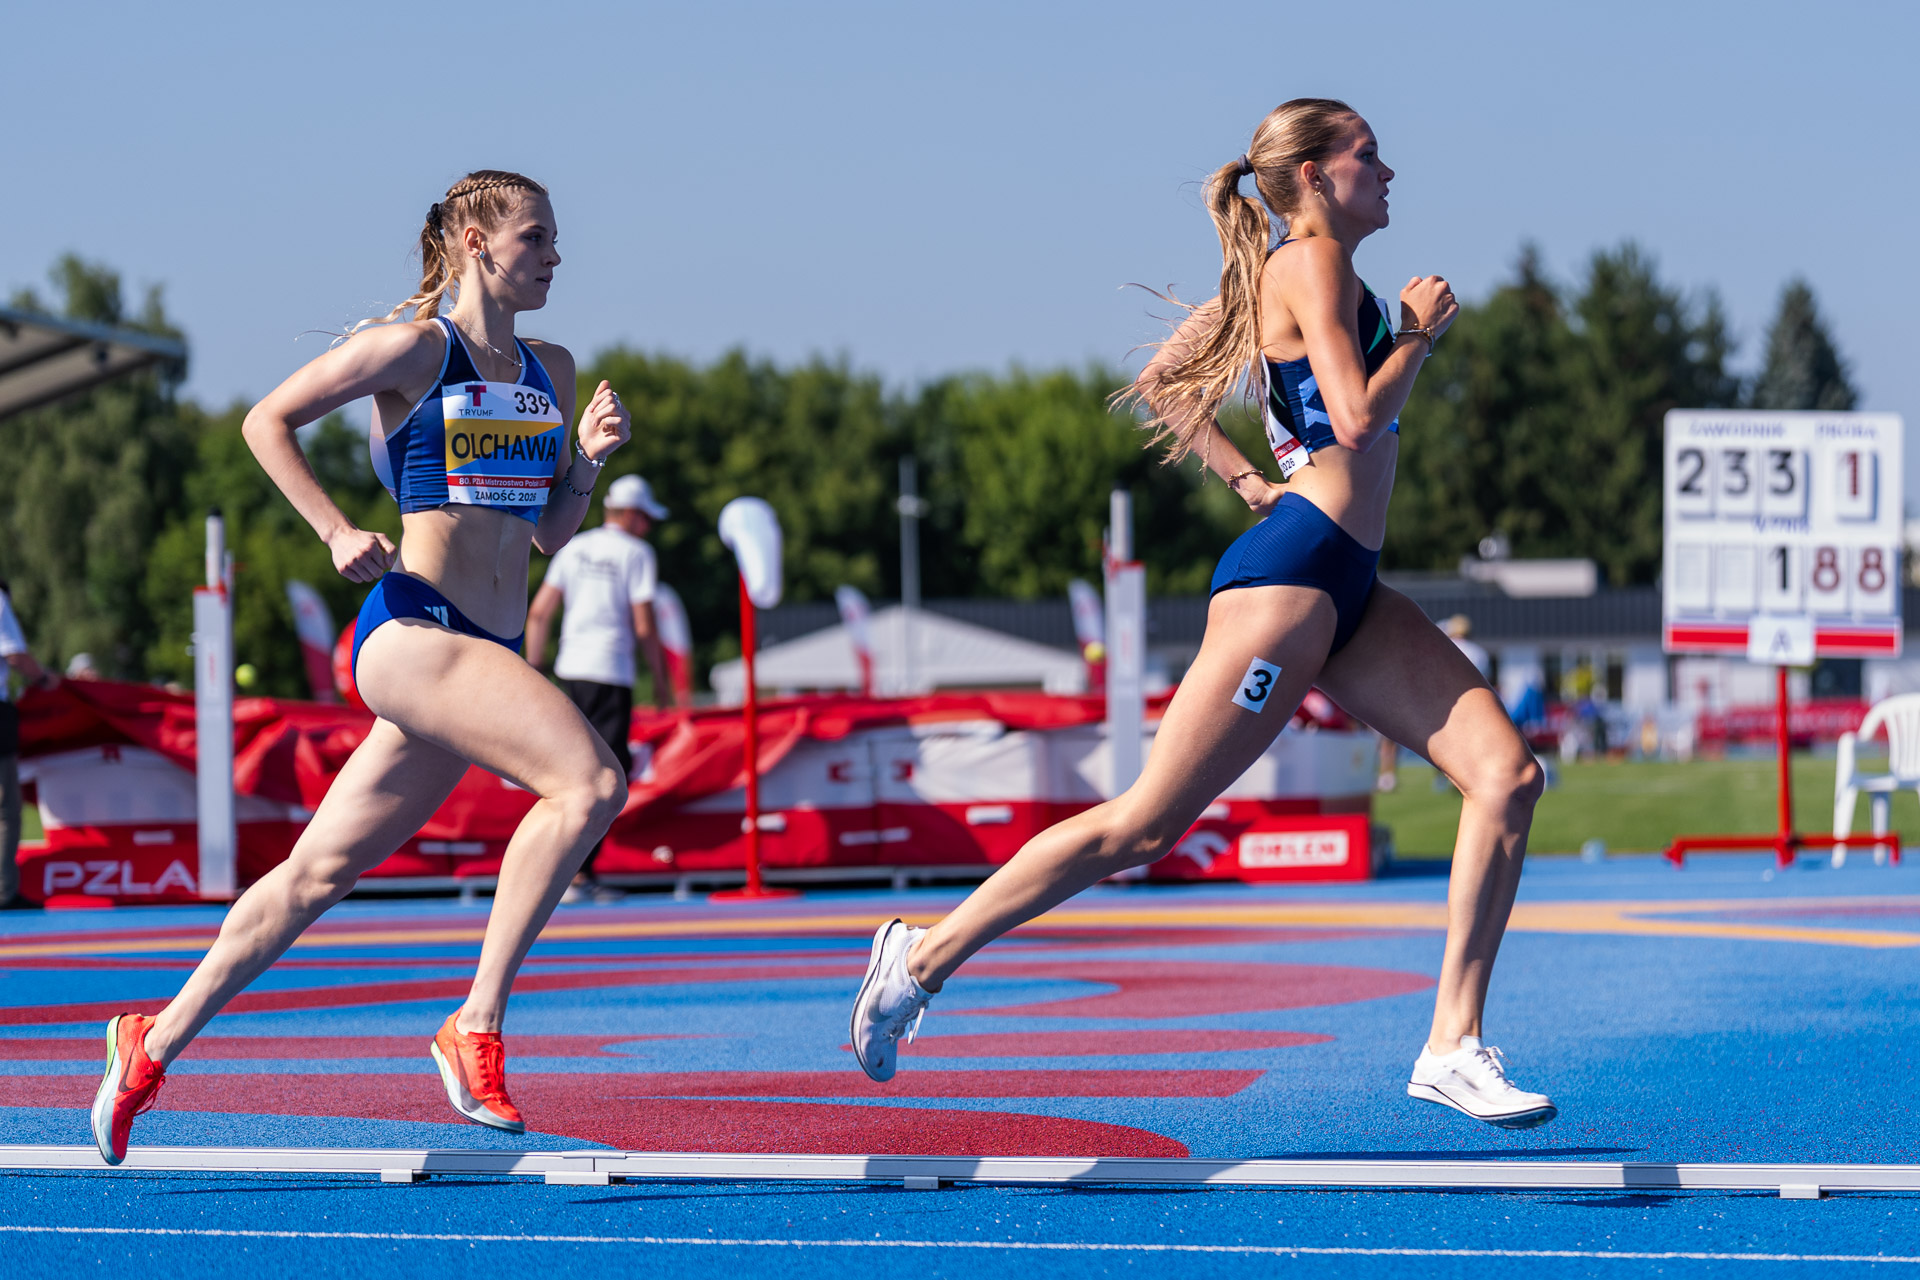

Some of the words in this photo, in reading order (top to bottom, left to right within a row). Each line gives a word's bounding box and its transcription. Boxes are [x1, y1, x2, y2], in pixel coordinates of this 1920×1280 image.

[458, 408, 493, 416] TRYUMF
[514, 391, 550, 415] 339
[451, 433, 557, 462] OLCHAWA
[459, 477, 471, 485] 80.
[485, 478, 524, 487] Mistrzostwa
[1678, 448, 1796, 496] 233
[1845, 451, 1859, 498] 1
[475, 489, 516, 501] ZAMOŚĆ
[518, 492, 537, 502] 2026
[1770, 627, 1792, 651] A
[1244, 669, 1272, 702] 3
[43, 859, 197, 896] PZLA
